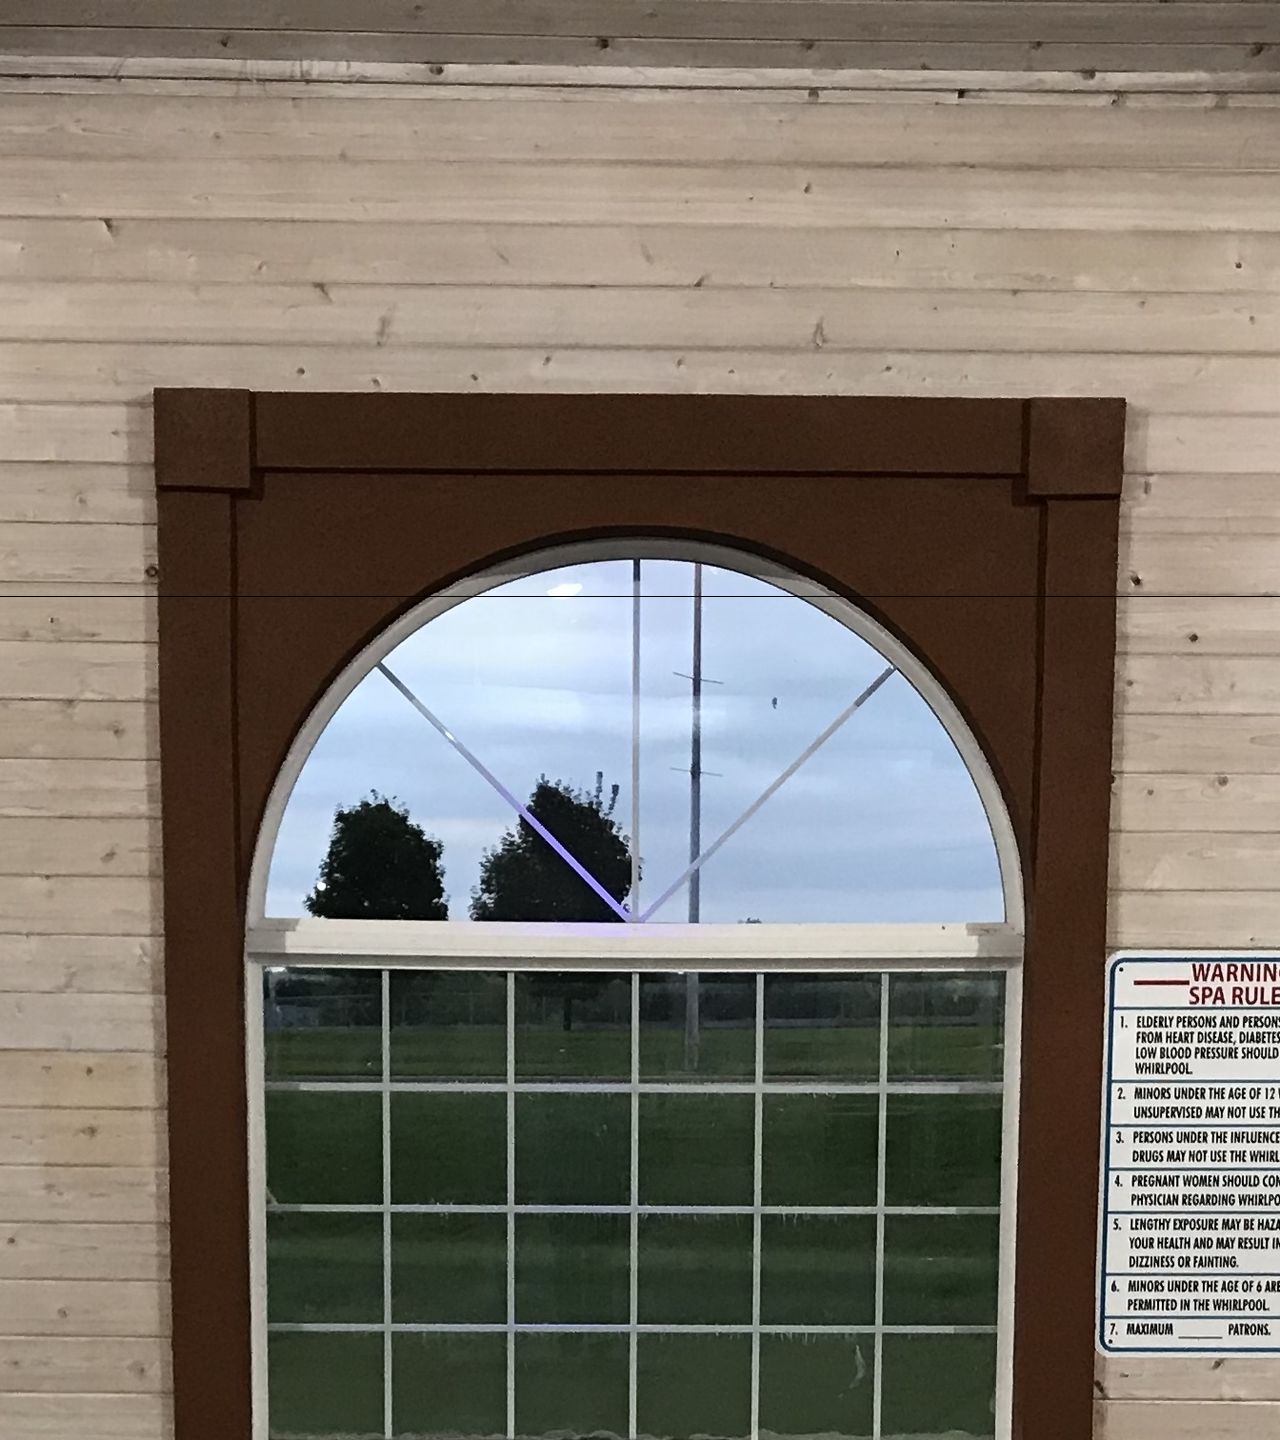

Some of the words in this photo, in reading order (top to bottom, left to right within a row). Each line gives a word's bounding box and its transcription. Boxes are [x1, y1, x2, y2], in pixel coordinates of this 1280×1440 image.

[1188, 986, 1226, 1005] SPA
[1120, 1016, 1128, 1028] 1.
[1136, 1015, 1174, 1028] ELDERLY
[1176, 1015, 1217, 1028] PERSONS
[1219, 1016, 1240, 1029] AND
[1136, 1031, 1163, 1044] FROM
[1165, 1031, 1195, 1044] HEART
[1197, 1031, 1236, 1046] DISEASE,
[1136, 1046, 1157, 1060] LOW
[1160, 1046, 1192, 1060] BLOOD
[1194, 1046, 1239, 1060] PRESSURE
[1241, 1046, 1279, 1060] SHOULD
[1135, 1062, 1193, 1075] WHIRLPOOL.
[1117, 1087, 1126, 1100] 2.
[1134, 1087, 1171, 1100] MINORS
[1174, 1087, 1206, 1100] UNDER
[1208, 1087, 1226, 1100] THE
[1228, 1087, 1246, 1100] AGE
[1249, 1087, 1262, 1100] OF
[1265, 1087, 1276, 1100] 12
[1134, 1106, 1203, 1119] UNSUPERVISED
[1204, 1106, 1226, 1119] MAY
[1227, 1106, 1247, 1119] NOT
[1249, 1106, 1266, 1119] USE
[1116, 1131, 1124, 1144] 3.
[1133, 1131, 1174, 1144] PERSONS
[1176, 1131, 1208, 1144] UNDER
[1210, 1131, 1228, 1144] THE
[1230, 1131, 1280, 1144] INFLUENCE
[1132, 1150, 1164, 1163] DRUGS
[1166, 1150, 1186, 1162] MAY
[1188, 1150, 1208, 1162] NOT
[1210, 1150, 1227, 1163] USE
[1229, 1150, 1247, 1163] THE
[1114, 1174, 1123, 1187] 4.
[1131, 1174, 1180, 1188] PREGNANT
[1182, 1174, 1220, 1188] WOMEN
[1222, 1174, 1260, 1188] SHOULD
[1131, 1193, 1179, 1206] PHYSICIAN
[1182, 1193, 1236, 1206] REGARDING
[1113, 1218, 1122, 1231] 5.
[1130, 1218, 1171, 1231] LENGTHY
[1173, 1218, 1219, 1231] EXPOSURE
[1221, 1218, 1242, 1231] MAY
[1243, 1218, 1255, 1231] BE
[1129, 1236, 1155, 1250] YOUR
[1157, 1236, 1191, 1250] HEALTH
[1193, 1237, 1214, 1250] AND
[1216, 1237, 1236, 1250] MAY
[1238, 1237, 1270, 1250] RESULT
[1129, 1255, 1175, 1268] DIZZINESS
[1177, 1256, 1191, 1268] OR
[1193, 1256, 1239, 1268] FAINTING.
[1111, 1280, 1120, 1292] 6.
[1128, 1280, 1165, 1293] MINORS
[1167, 1280, 1199, 1293] UNDER
[1201, 1280, 1219, 1293] THE
[1220, 1280, 1239, 1293] AGE
[1241, 1280, 1254, 1293] OF
[1256, 1280, 1262, 1293] 6
[1127, 1298, 1178, 1311] PERMITTED
[1180, 1299, 1190, 1311] IN
[1193, 1298, 1210, 1311] THE
[1212, 1298, 1270, 1311] WHIRLPOOL.
[1110, 1322, 1118, 1336] 7.
[1126, 1323, 1174, 1336] MAXIMUM
[1228, 1323, 1271, 1336] PATRONS.
